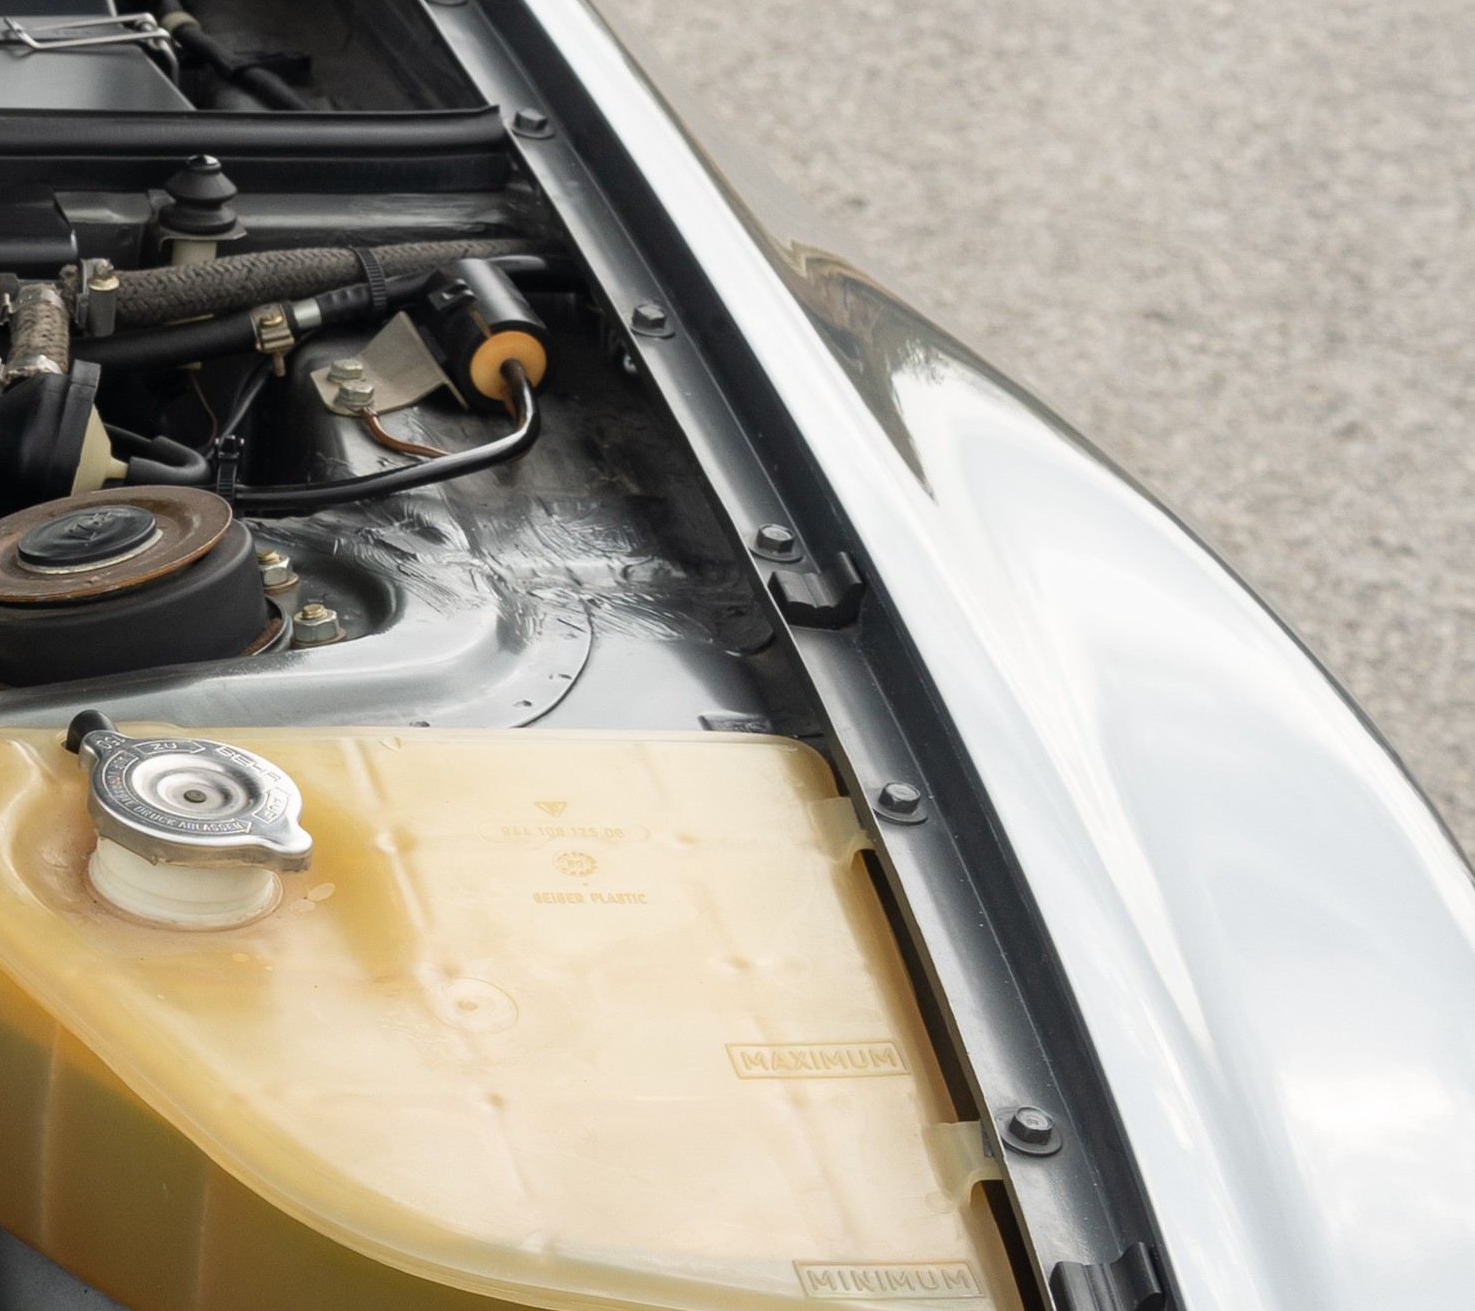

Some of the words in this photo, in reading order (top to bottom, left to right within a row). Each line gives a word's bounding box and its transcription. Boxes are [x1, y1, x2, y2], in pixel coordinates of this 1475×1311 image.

[151, 741, 178, 751] ZU
[215, 744, 282, 783] BEHR
[590, 892, 648, 906] PLASTIC
[741, 1046, 900, 1073] MAXIMUM
[807, 1264, 968, 1293] MINIMUM
